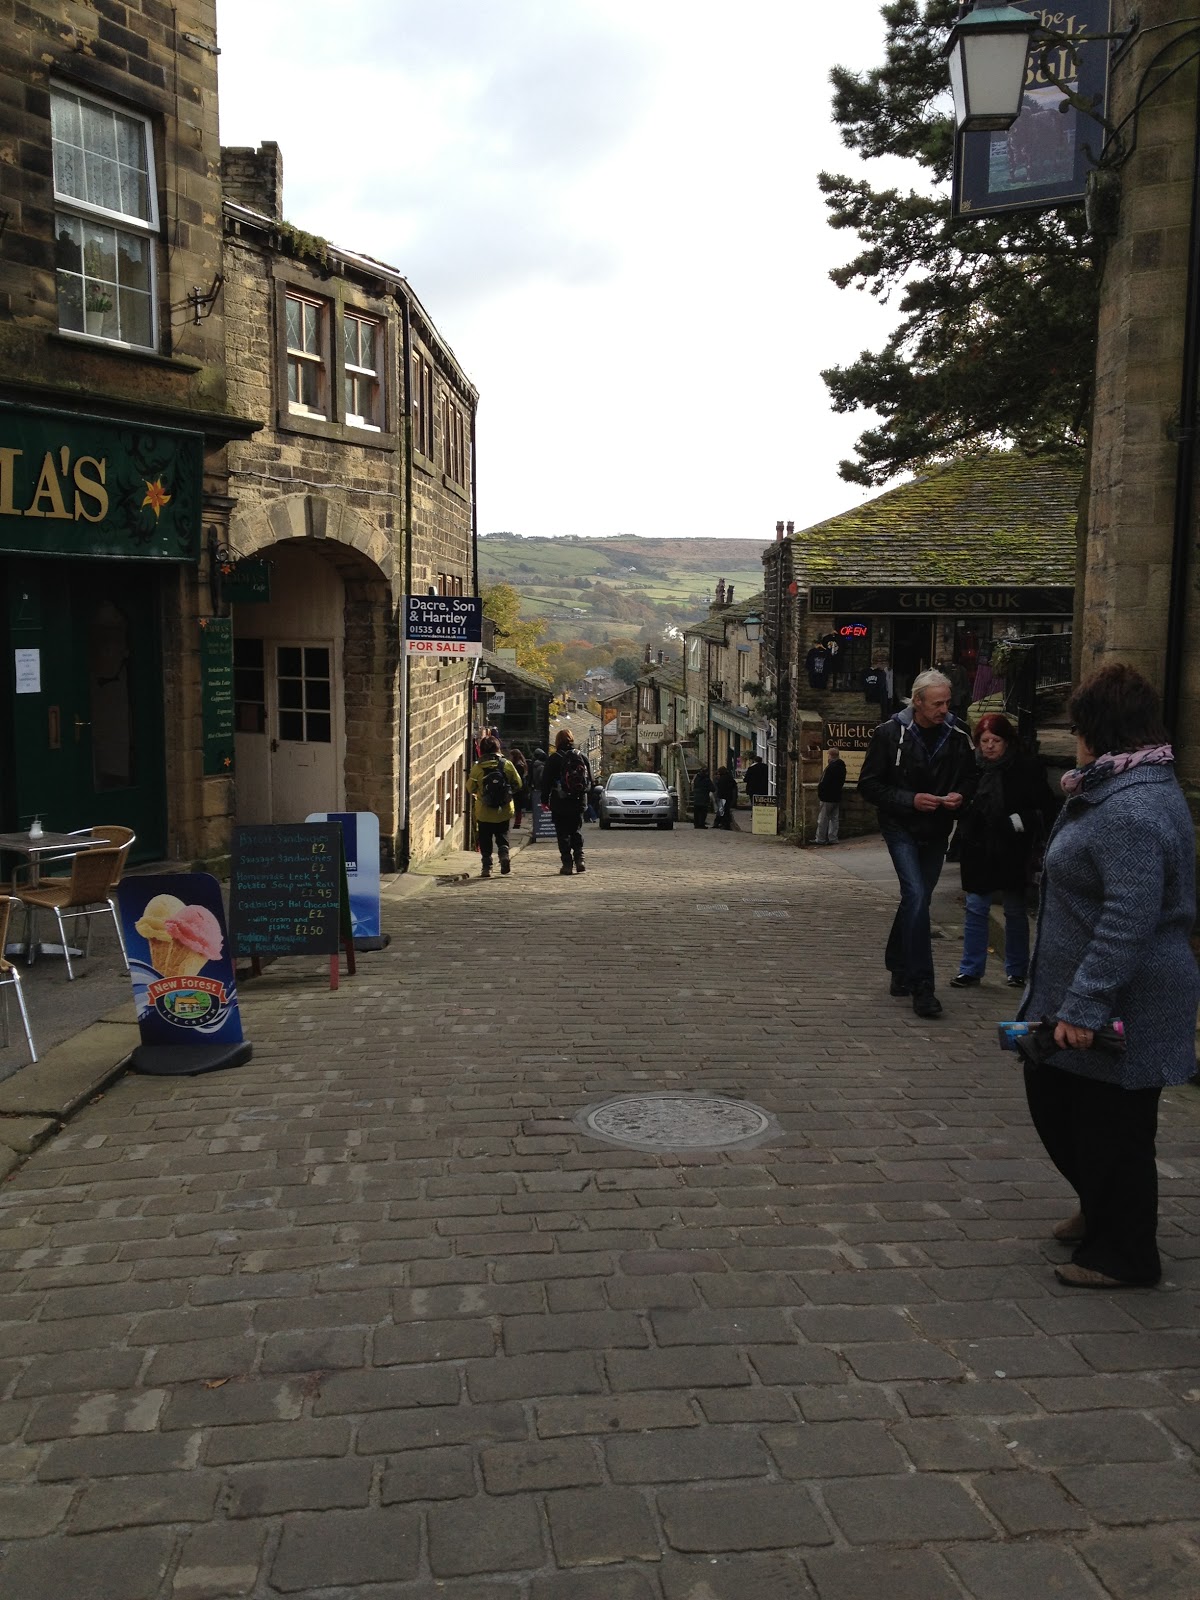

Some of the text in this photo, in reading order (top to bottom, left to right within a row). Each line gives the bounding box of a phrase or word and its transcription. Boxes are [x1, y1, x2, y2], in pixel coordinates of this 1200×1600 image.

[409, 598, 475, 612] Dacre, Son
[815, 596, 831, 604] 117
[899, 592, 1020, 608] THE SOUK
[409, 611, 467, 626] & Hartley
[409, 625, 466, 635] 01535 611511
[840, 626, 868, 636] OPEN
[409, 641, 466, 652] FOR SALE
[639, 730, 664, 739] Stirrup
[827, 723, 875, 738] Villette
[827, 739, 870, 748] Coffee Hou
[311, 843, 327, 854] £2
[277, 853, 333, 863] Sandwiches
[311, 863, 326, 872] £2
[289, 872, 310, 880] Leek
[237, 881, 267, 890] Potato
[271, 880, 294, 893] Soup
[308, 909, 325, 919] £2
[154, 978, 217, 994] New Forest
[163, 1008, 216, 1025] ICE CREAM
